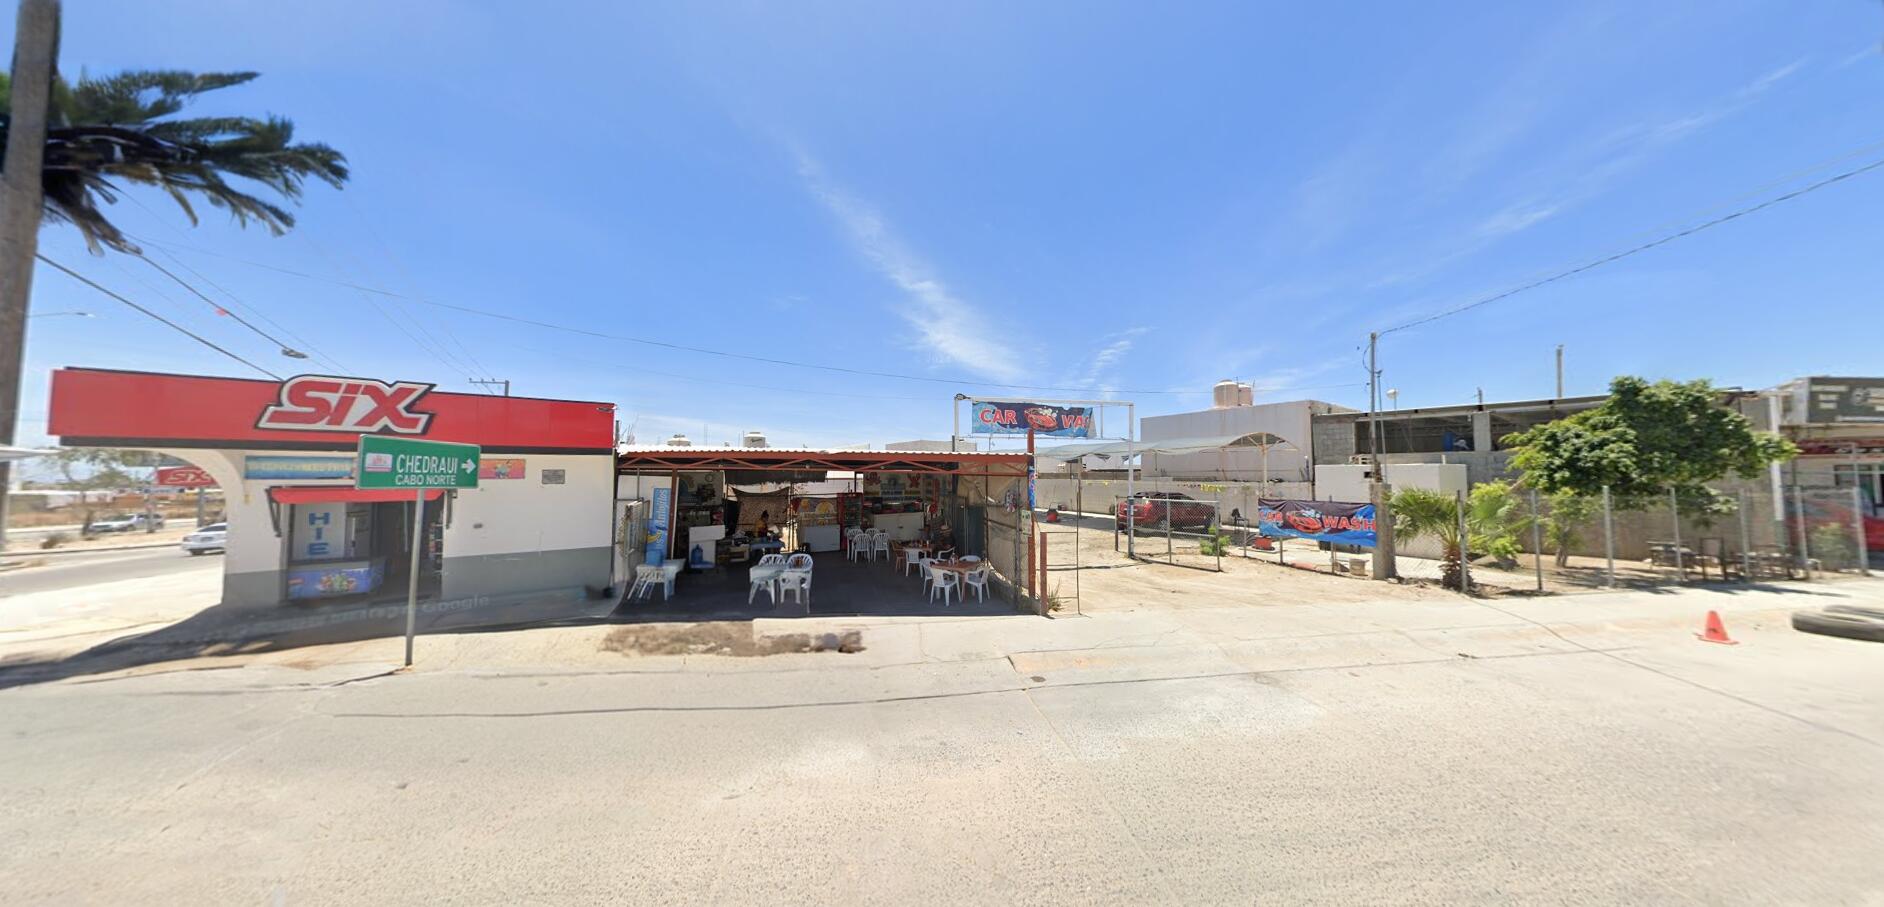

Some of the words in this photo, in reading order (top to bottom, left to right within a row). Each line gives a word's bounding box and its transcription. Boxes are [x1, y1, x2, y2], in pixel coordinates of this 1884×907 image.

[979, 408, 1018, 425] CAR
[396, 454, 459, 474] CHEDRAUI
[395, 474, 425, 486] CABO
[426, 475, 457, 486] NORTE
[1322, 514, 1377, 532] WASH
